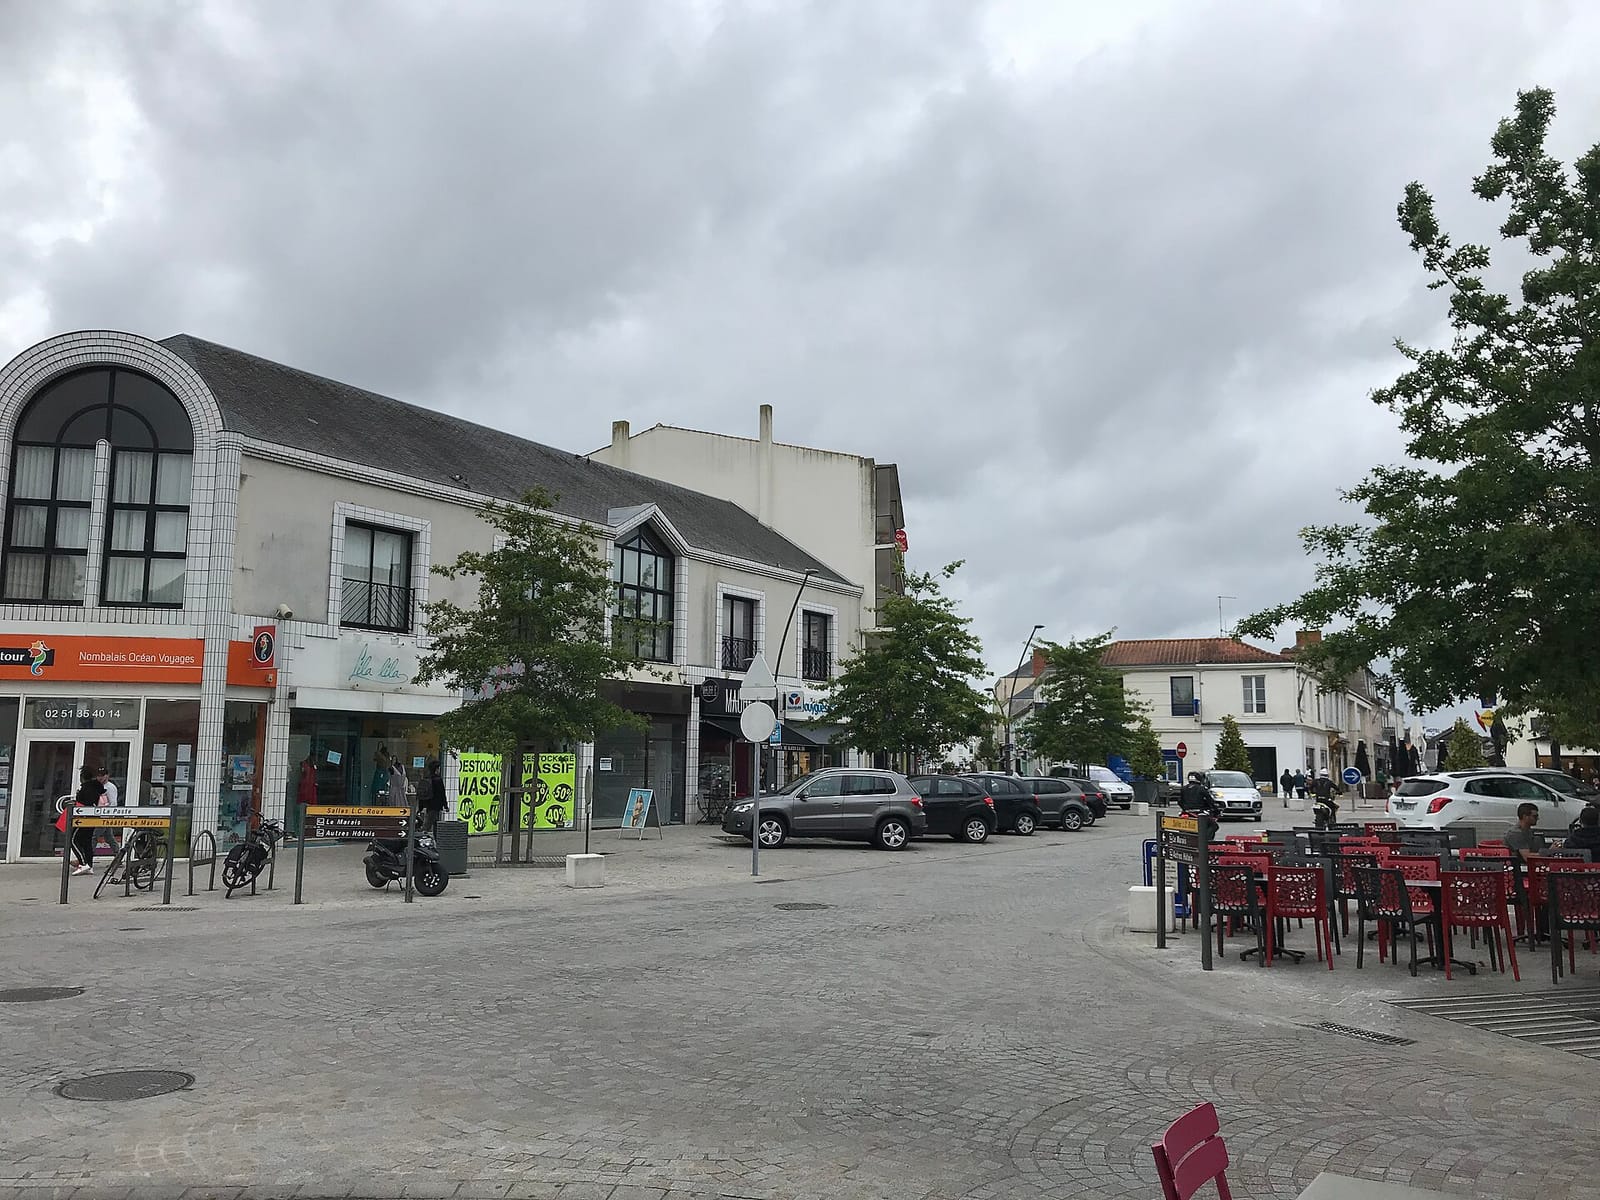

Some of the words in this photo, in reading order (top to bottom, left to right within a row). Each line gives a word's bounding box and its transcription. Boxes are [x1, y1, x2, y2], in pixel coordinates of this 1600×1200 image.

[79, 651, 126, 662] Nombalais
[128, 652, 156, 662] Océan
[158, 653, 195, 664] Voyages
[45, 709, 58, 718] 02
[61, 709, 73, 718] 51
[76, 709, 90, 718] 35
[92, 709, 105, 718] 40
[108, 709, 121, 718] 14
